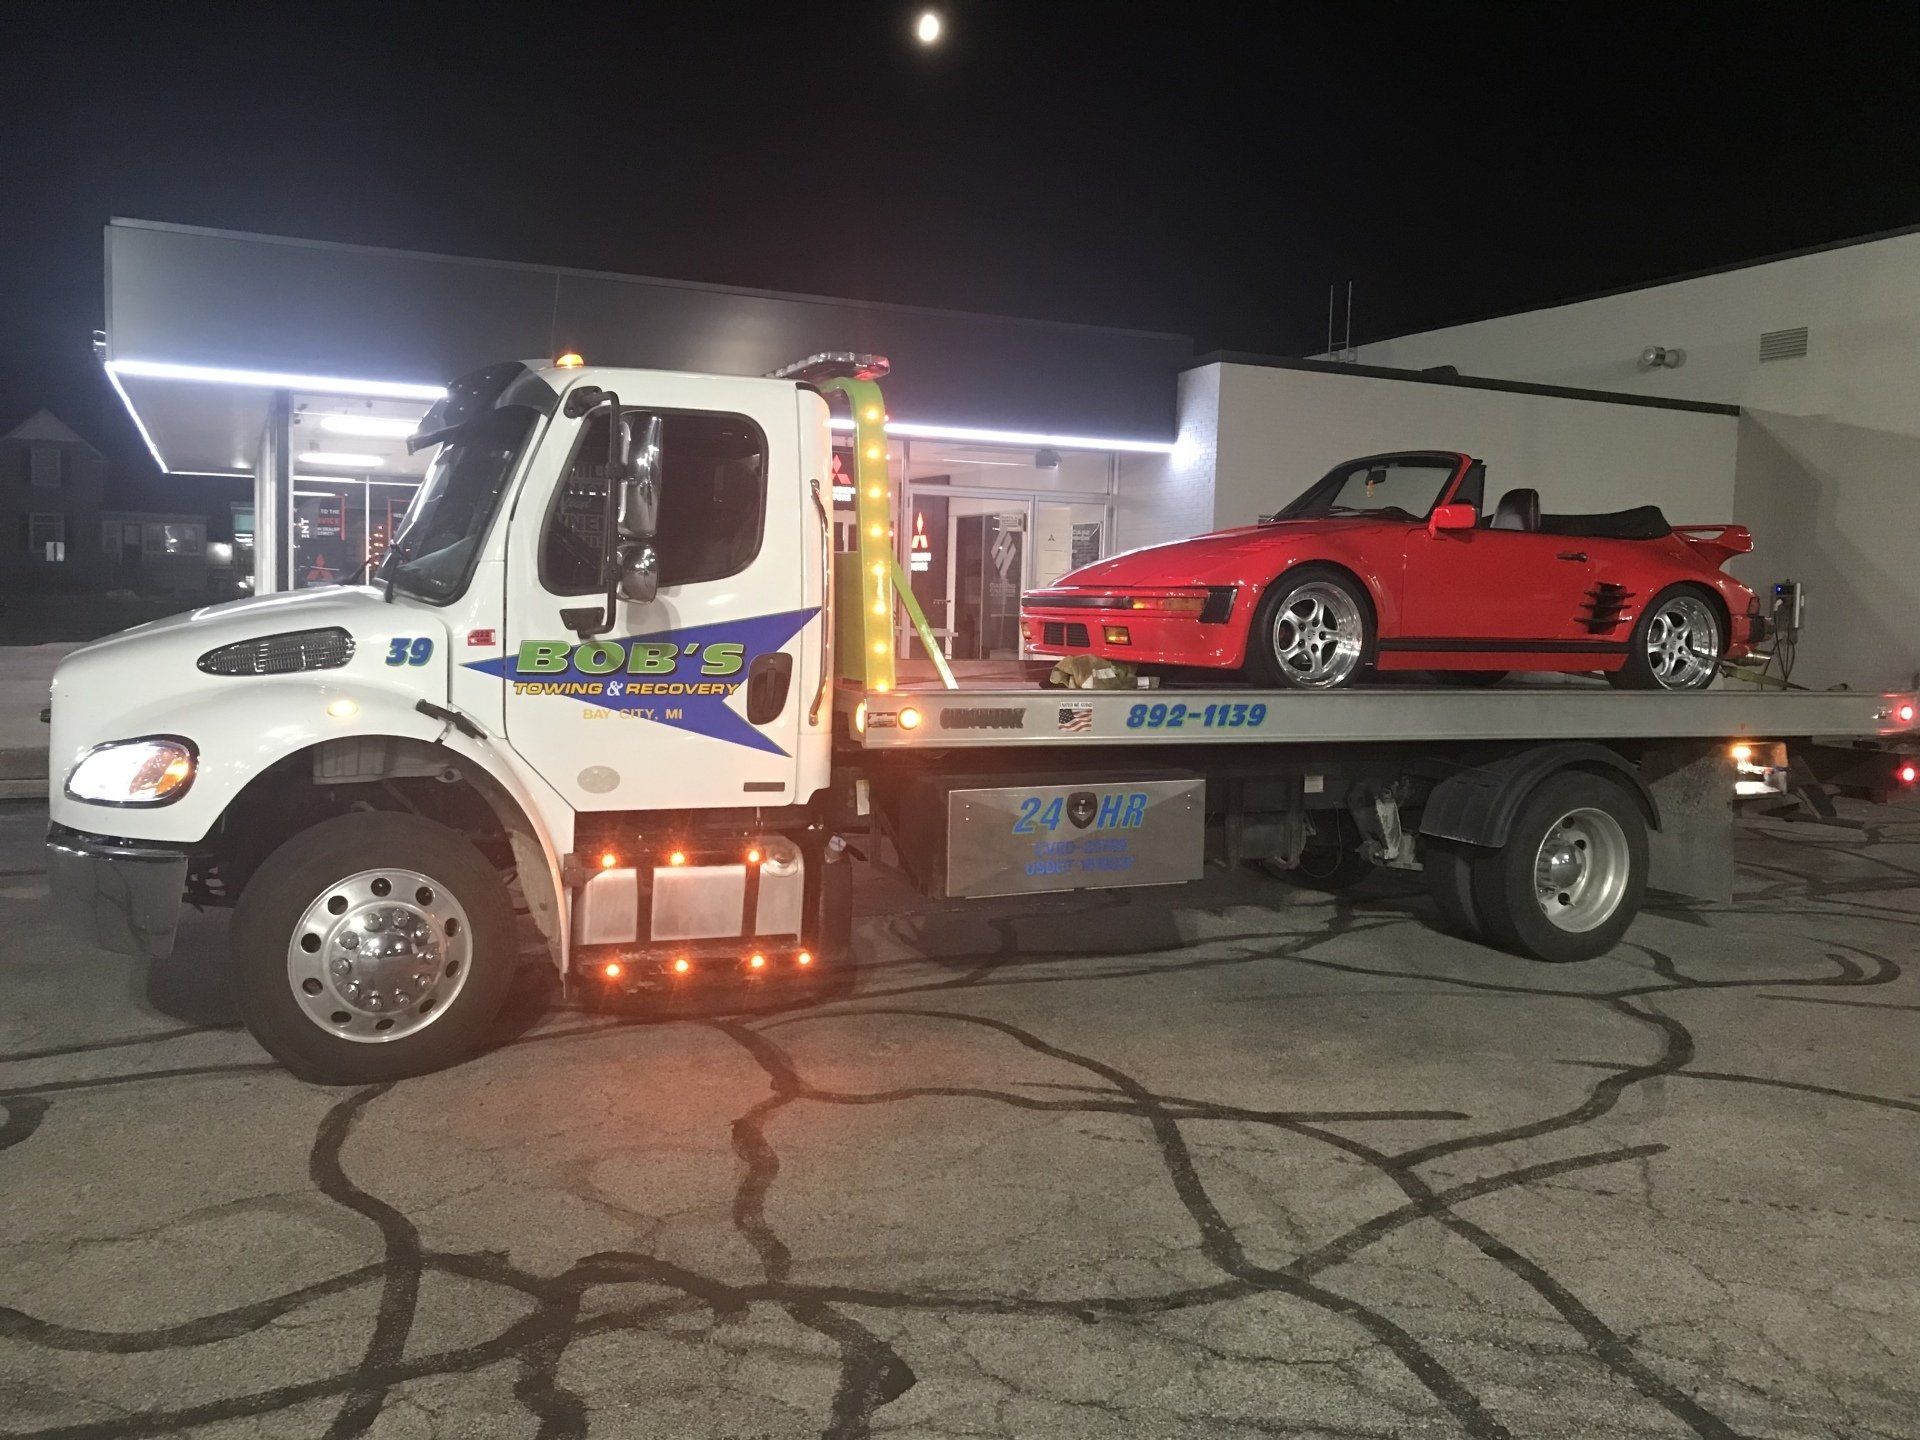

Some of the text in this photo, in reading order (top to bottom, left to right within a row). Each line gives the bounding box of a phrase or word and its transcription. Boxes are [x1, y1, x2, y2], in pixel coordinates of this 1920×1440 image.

[384, 637, 435, 667] 39
[516, 639, 746, 676] BOB'S
[513, 680, 741, 697] TOWING & RECOVERY
[583, 708, 683, 721] BAY CITY, MI
[1126, 703, 1268, 729] 892-1139
[1012, 792, 1149, 834] 24 HR
